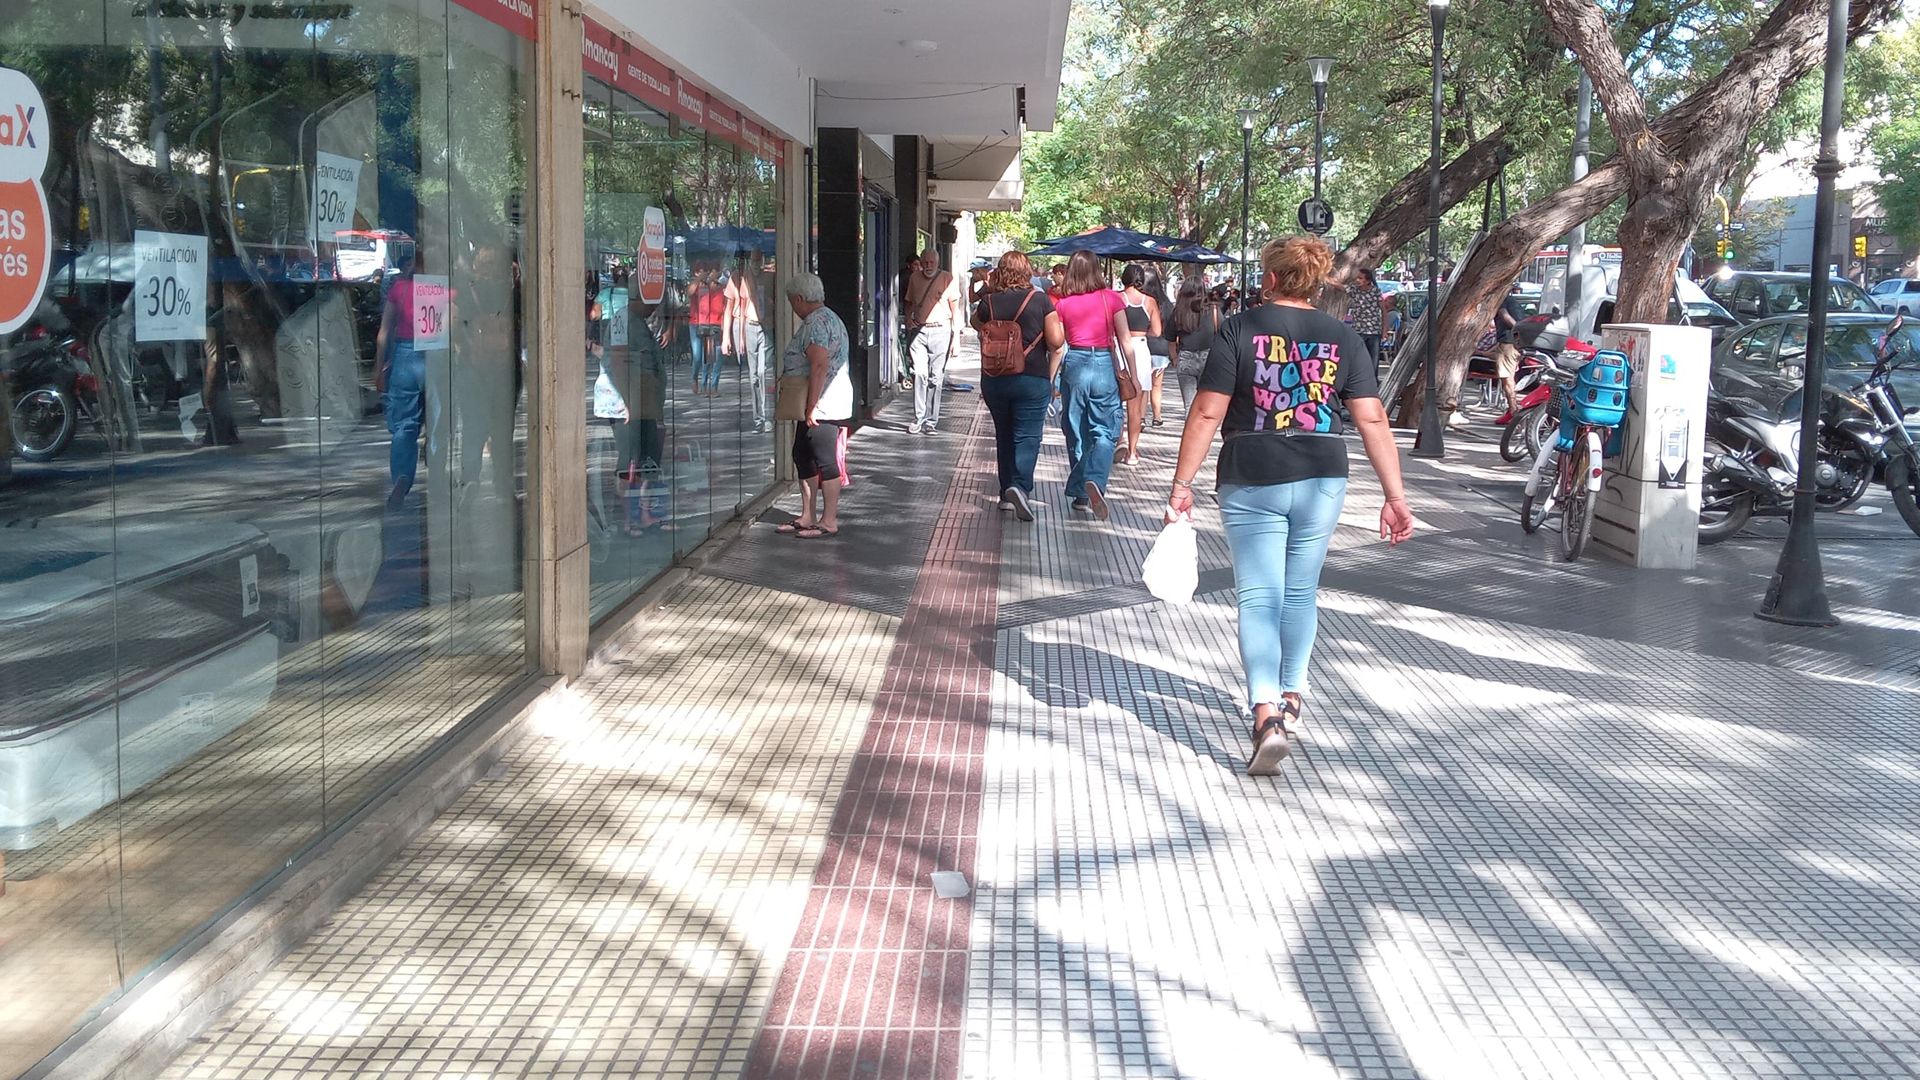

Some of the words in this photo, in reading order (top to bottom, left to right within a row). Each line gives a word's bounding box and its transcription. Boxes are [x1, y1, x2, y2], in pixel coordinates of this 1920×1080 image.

[0, 246, 28, 277] és
[141, 246, 198, 264] VENTILACIÓN
[143, 275, 191, 317] -30%
[418, 305, 442, 334] -30%
[1252, 335, 1340, 363] TRAVEL
[1254, 359, 1337, 392] MORE
[1252, 382, 1336, 411] WORRY
